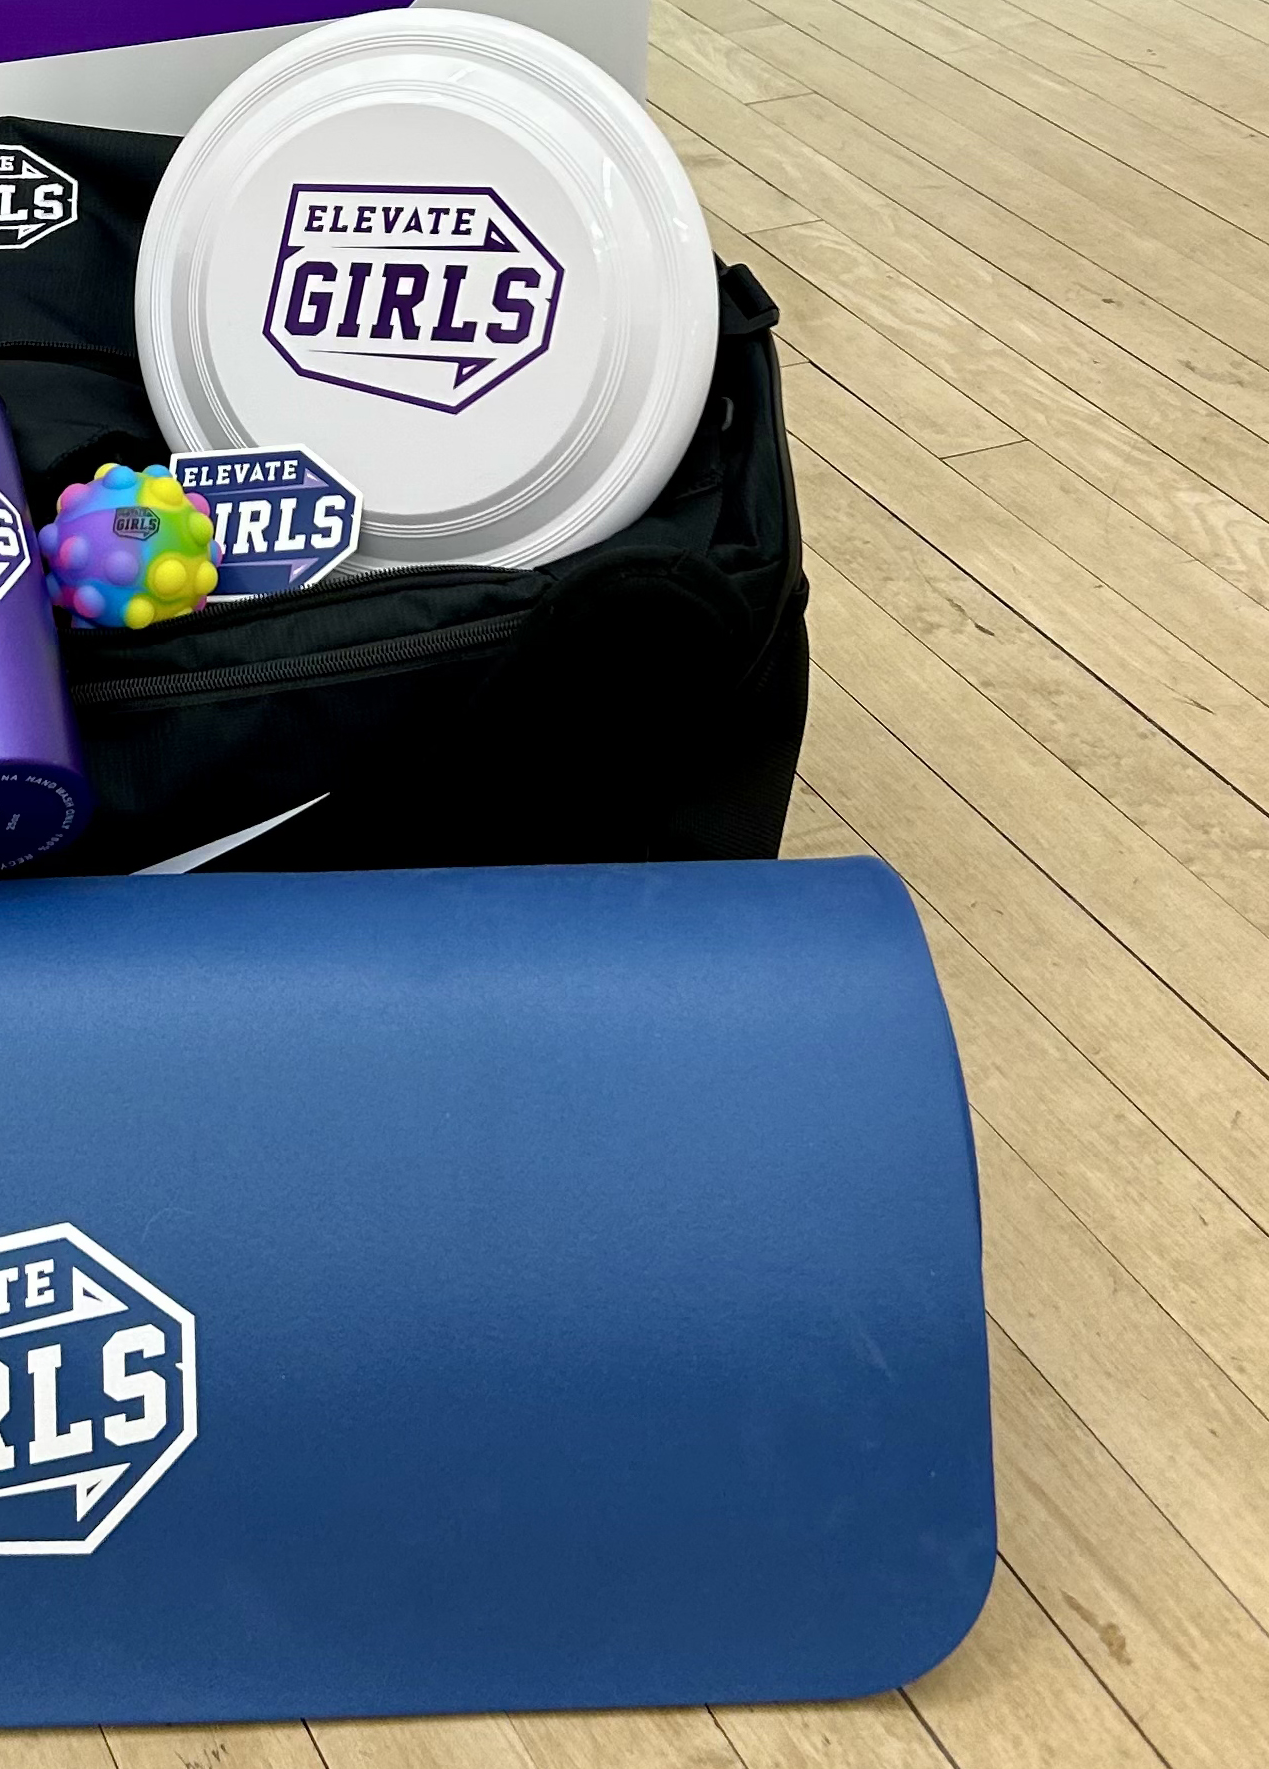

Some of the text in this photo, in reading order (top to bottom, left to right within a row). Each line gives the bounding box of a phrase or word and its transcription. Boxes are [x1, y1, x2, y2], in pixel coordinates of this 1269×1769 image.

[304, 205, 476, 235] ELEVATE
[284, 261, 541, 344] GIRLS
[183, 459, 298, 487] ELEVATE
[116, 518, 158, 531] GIRLS
[215, 494, 346, 555] IRLS
[25, 775, 58, 789] HAND
